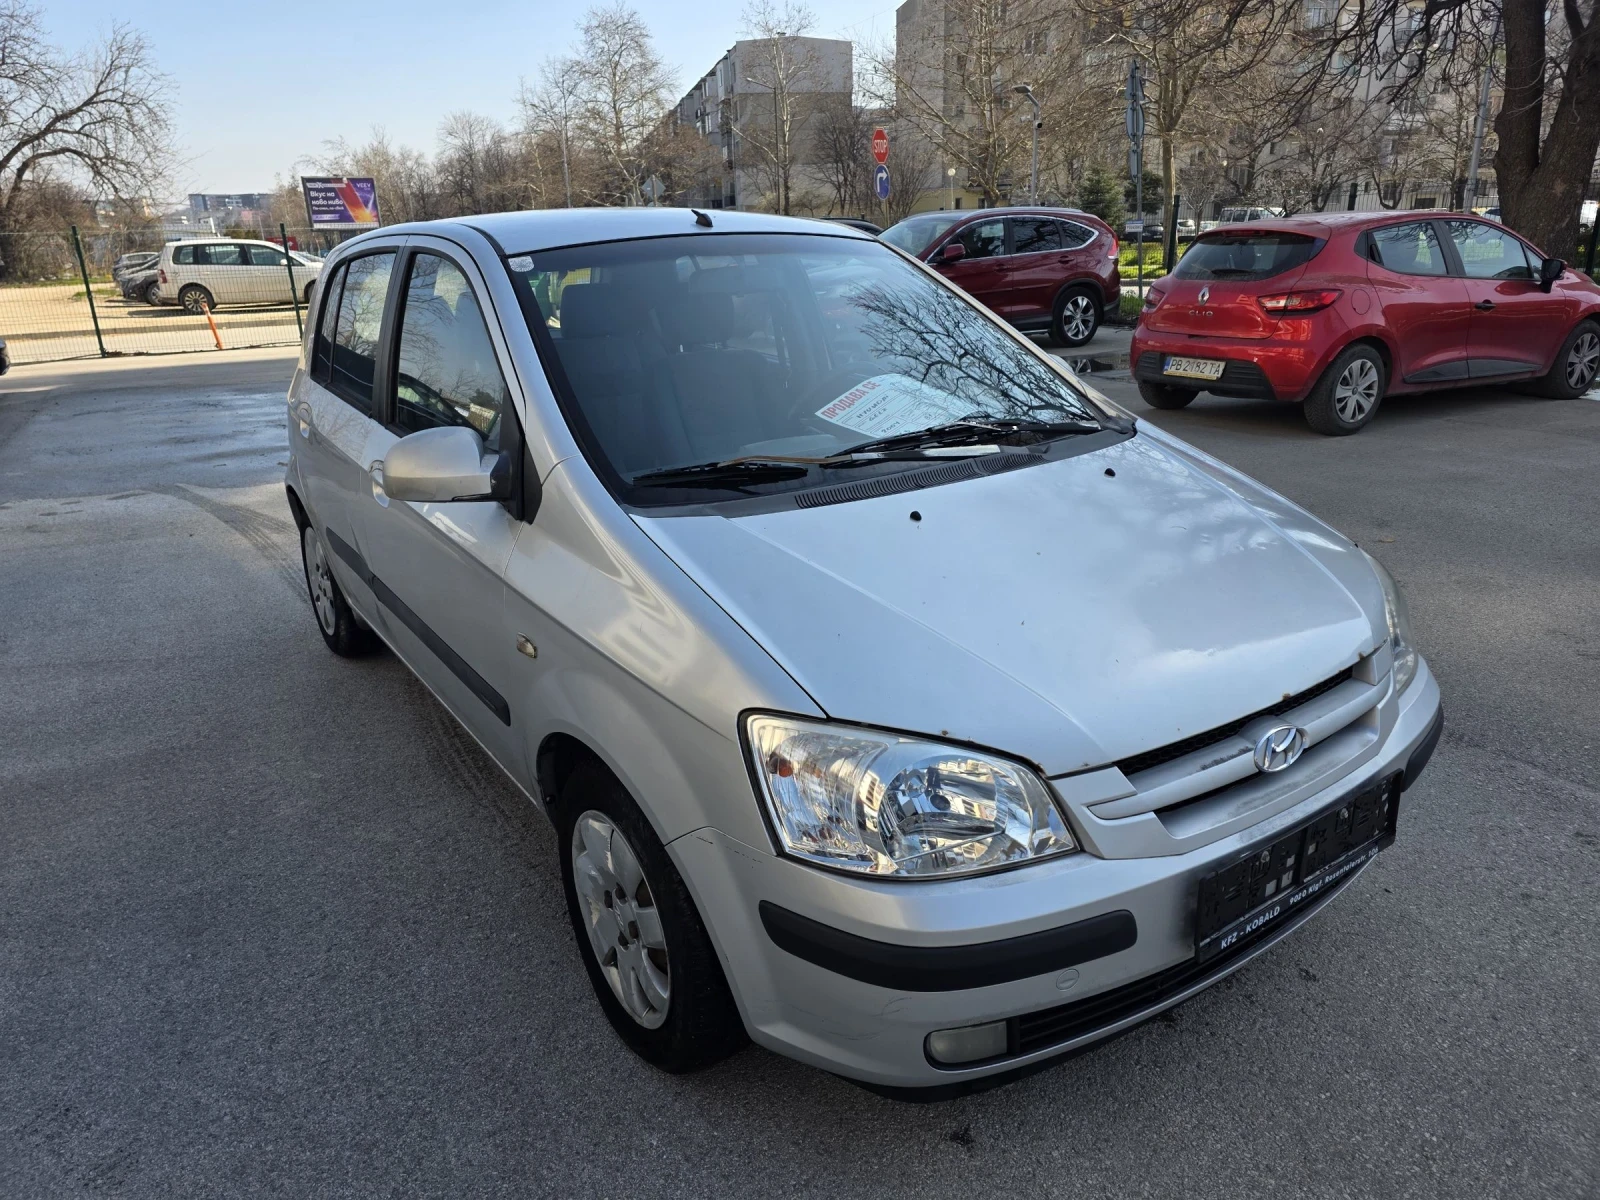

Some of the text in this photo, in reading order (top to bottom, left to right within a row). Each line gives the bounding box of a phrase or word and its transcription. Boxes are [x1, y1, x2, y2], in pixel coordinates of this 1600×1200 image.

[874, 139, 888, 153] STOP
[309, 190, 326, 198] Вкус
[820, 381, 880, 419] ПРОДАВА СЕ
[1221, 931, 1238, 949] KFZ
[1246, 906, 1280, 933] KOBALD
